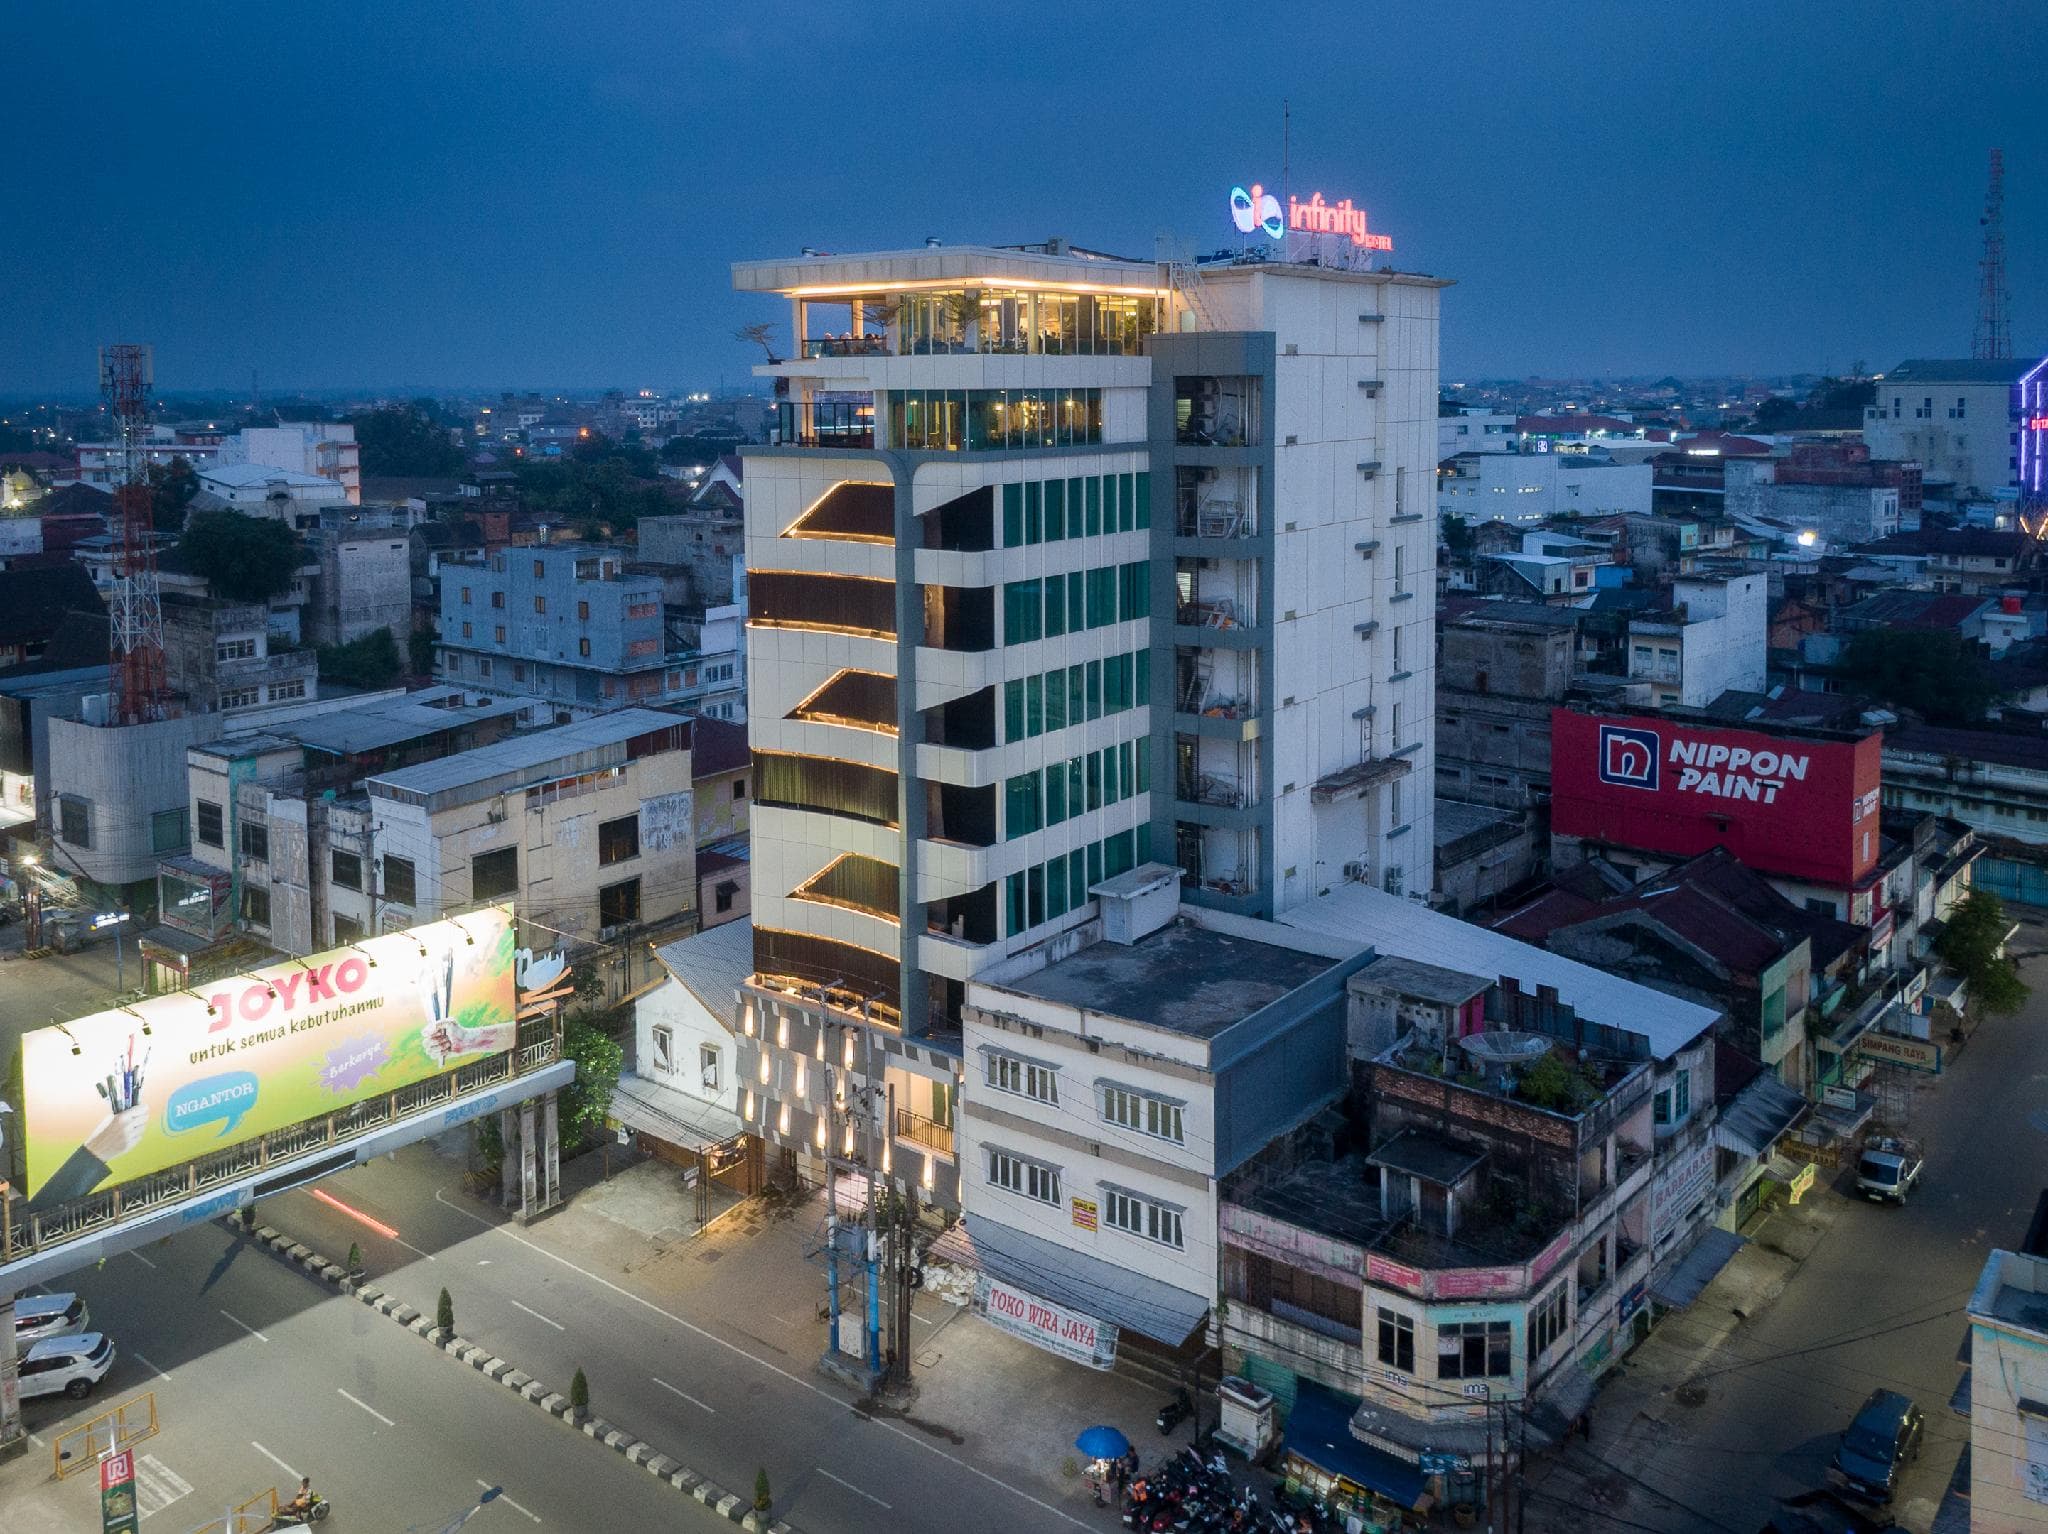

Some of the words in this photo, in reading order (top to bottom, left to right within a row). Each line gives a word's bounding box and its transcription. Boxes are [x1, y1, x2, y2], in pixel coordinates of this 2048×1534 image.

[1290, 191, 1365, 245] infinity
[1669, 739, 1809, 781] NIPPON
[1677, 767, 1785, 804] PAINT
[208, 958, 367, 1033] JOYKO
[190, 1038, 236, 1064] untuk
[240, 1025, 286, 1049] semua
[290, 996, 384, 1035] kebutuhanmu
[1862, 1038, 1901, 1056] SIMPANG
[329, 1042, 382, 1079] Berkarya
[175, 1082, 254, 1117] NGANTOR
[990, 1288, 1025, 1318] TOKO
[1028, 1304, 1058, 1333] WIRA
[1062, 1319, 1095, 1347] JAYA
